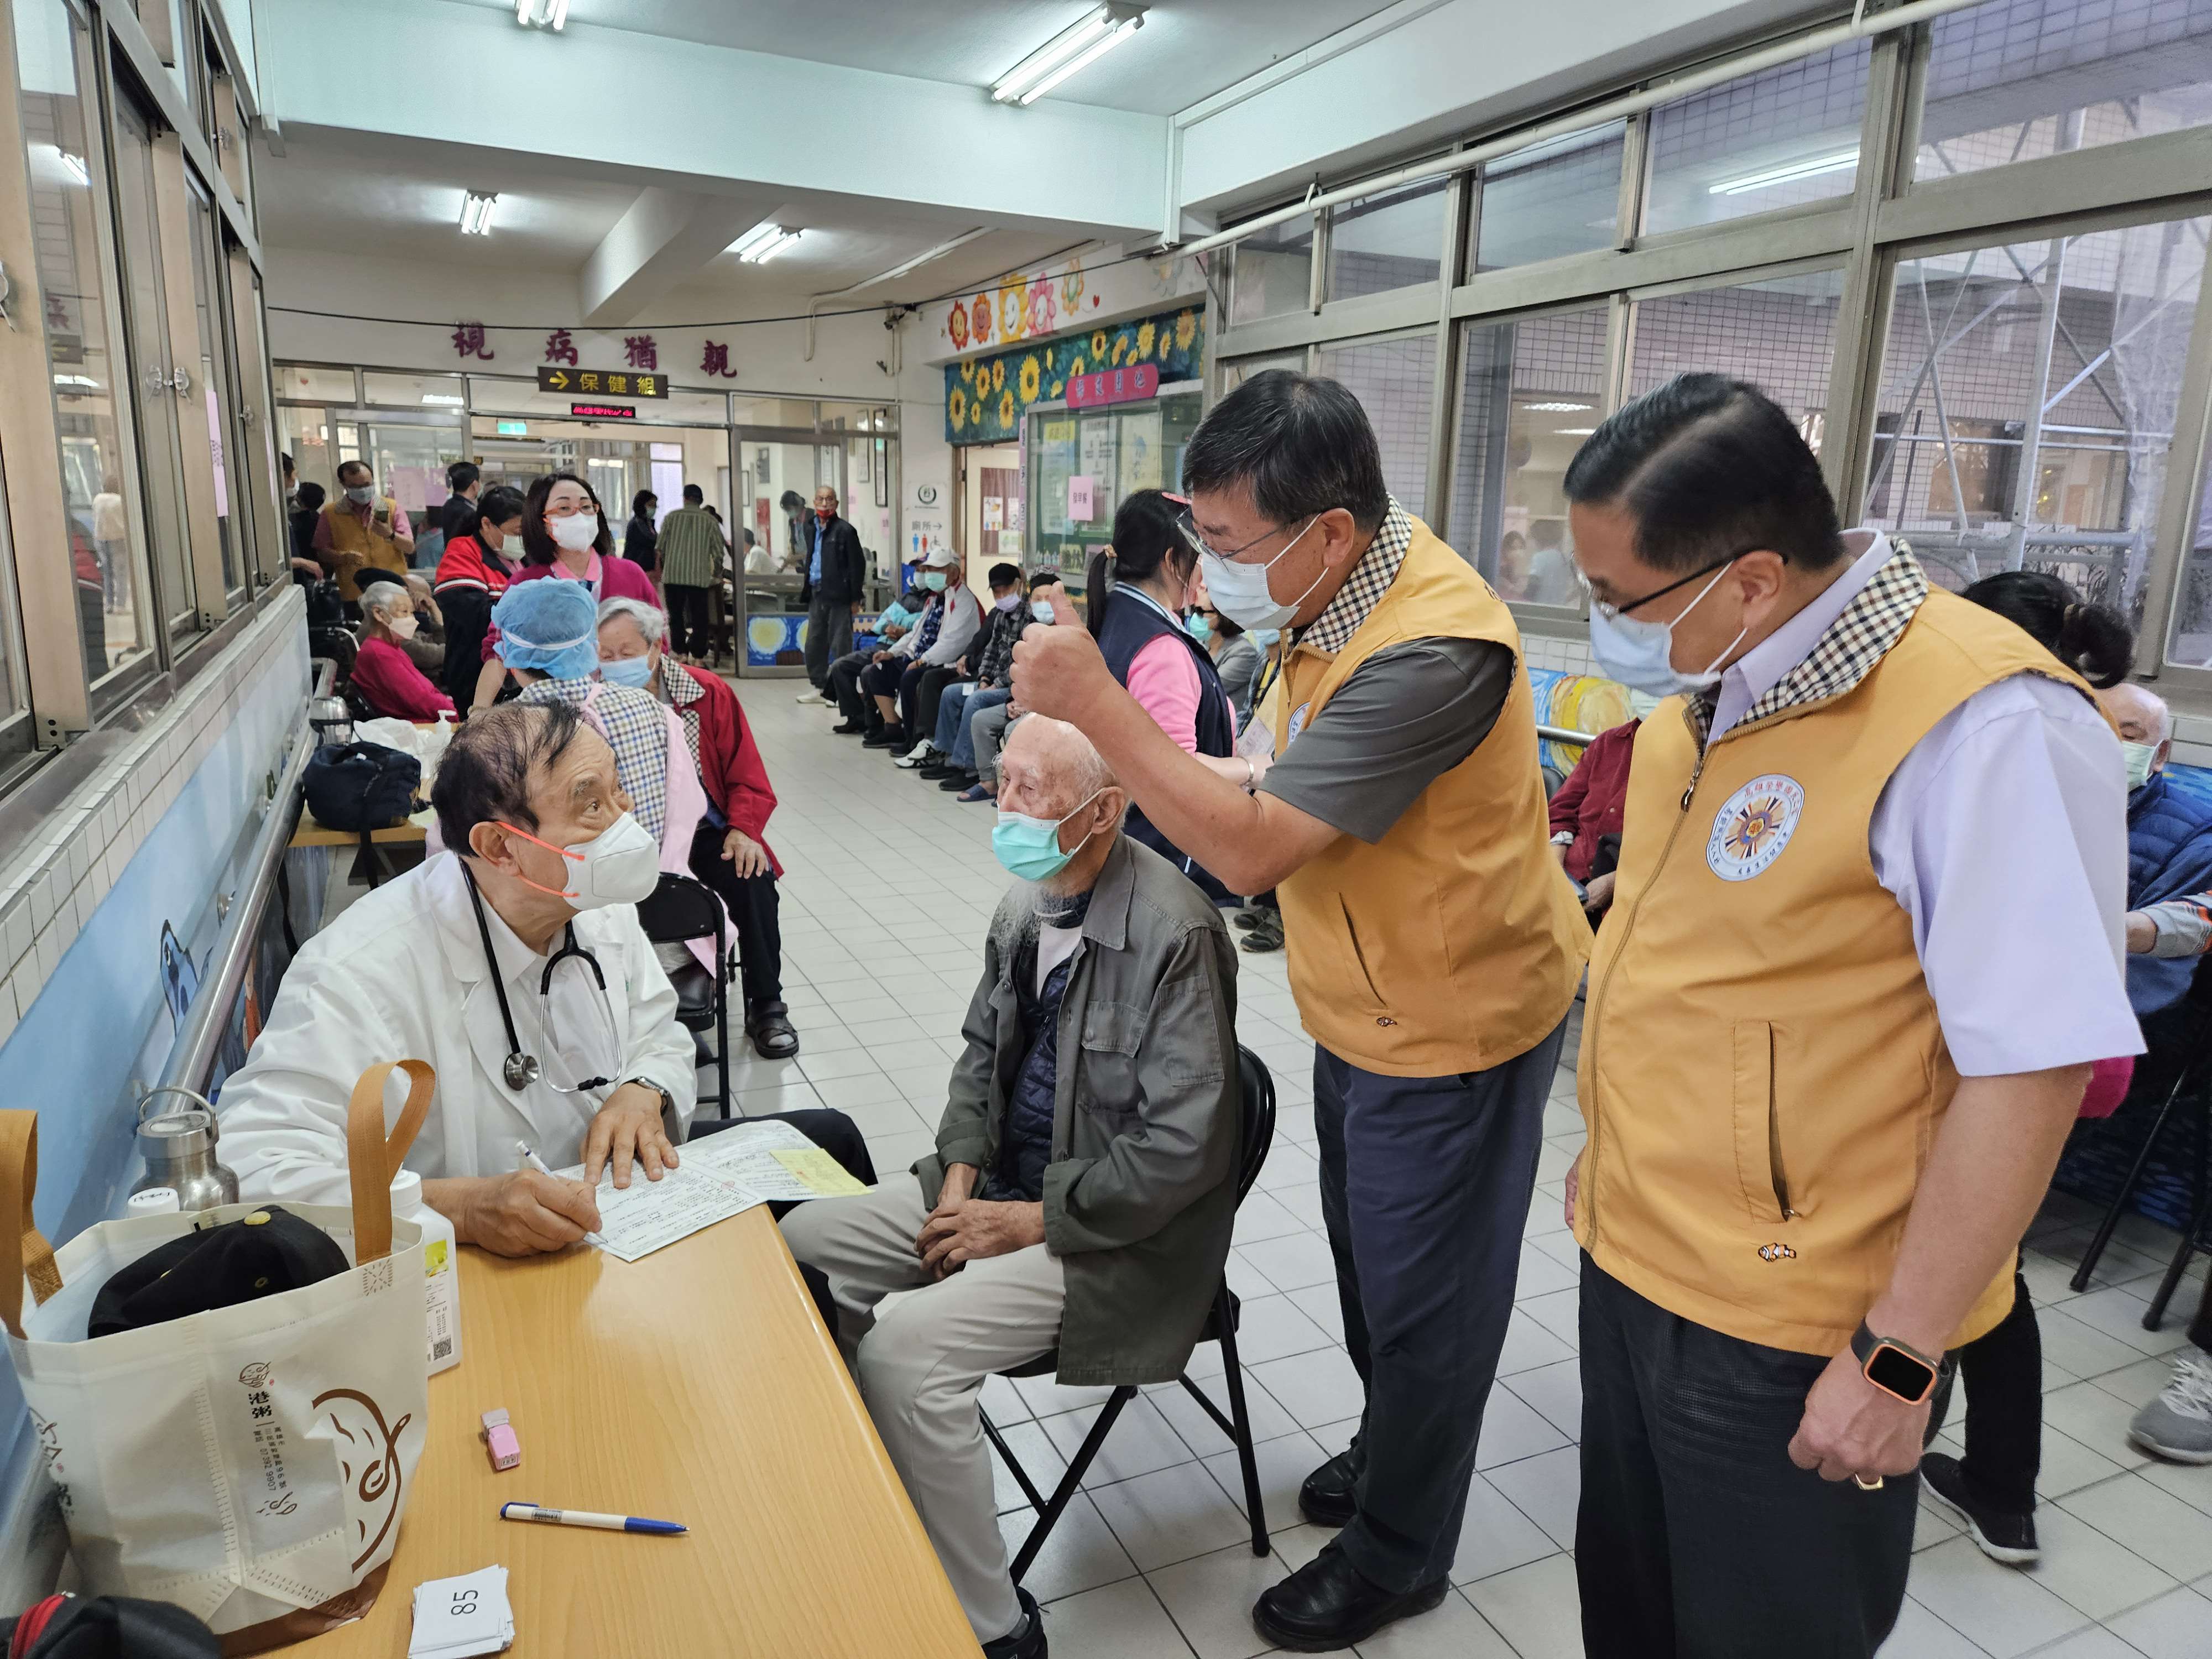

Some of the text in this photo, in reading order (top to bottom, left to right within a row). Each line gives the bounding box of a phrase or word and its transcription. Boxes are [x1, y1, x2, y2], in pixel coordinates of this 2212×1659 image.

[451, 319, 737, 378] 視病猶親
[579, 372, 657, 395] 保健組
[911, 521, 931, 531] 廁所
[248, 1390, 273, 1419] 港粥
[451, 1590, 478, 1615] 85
